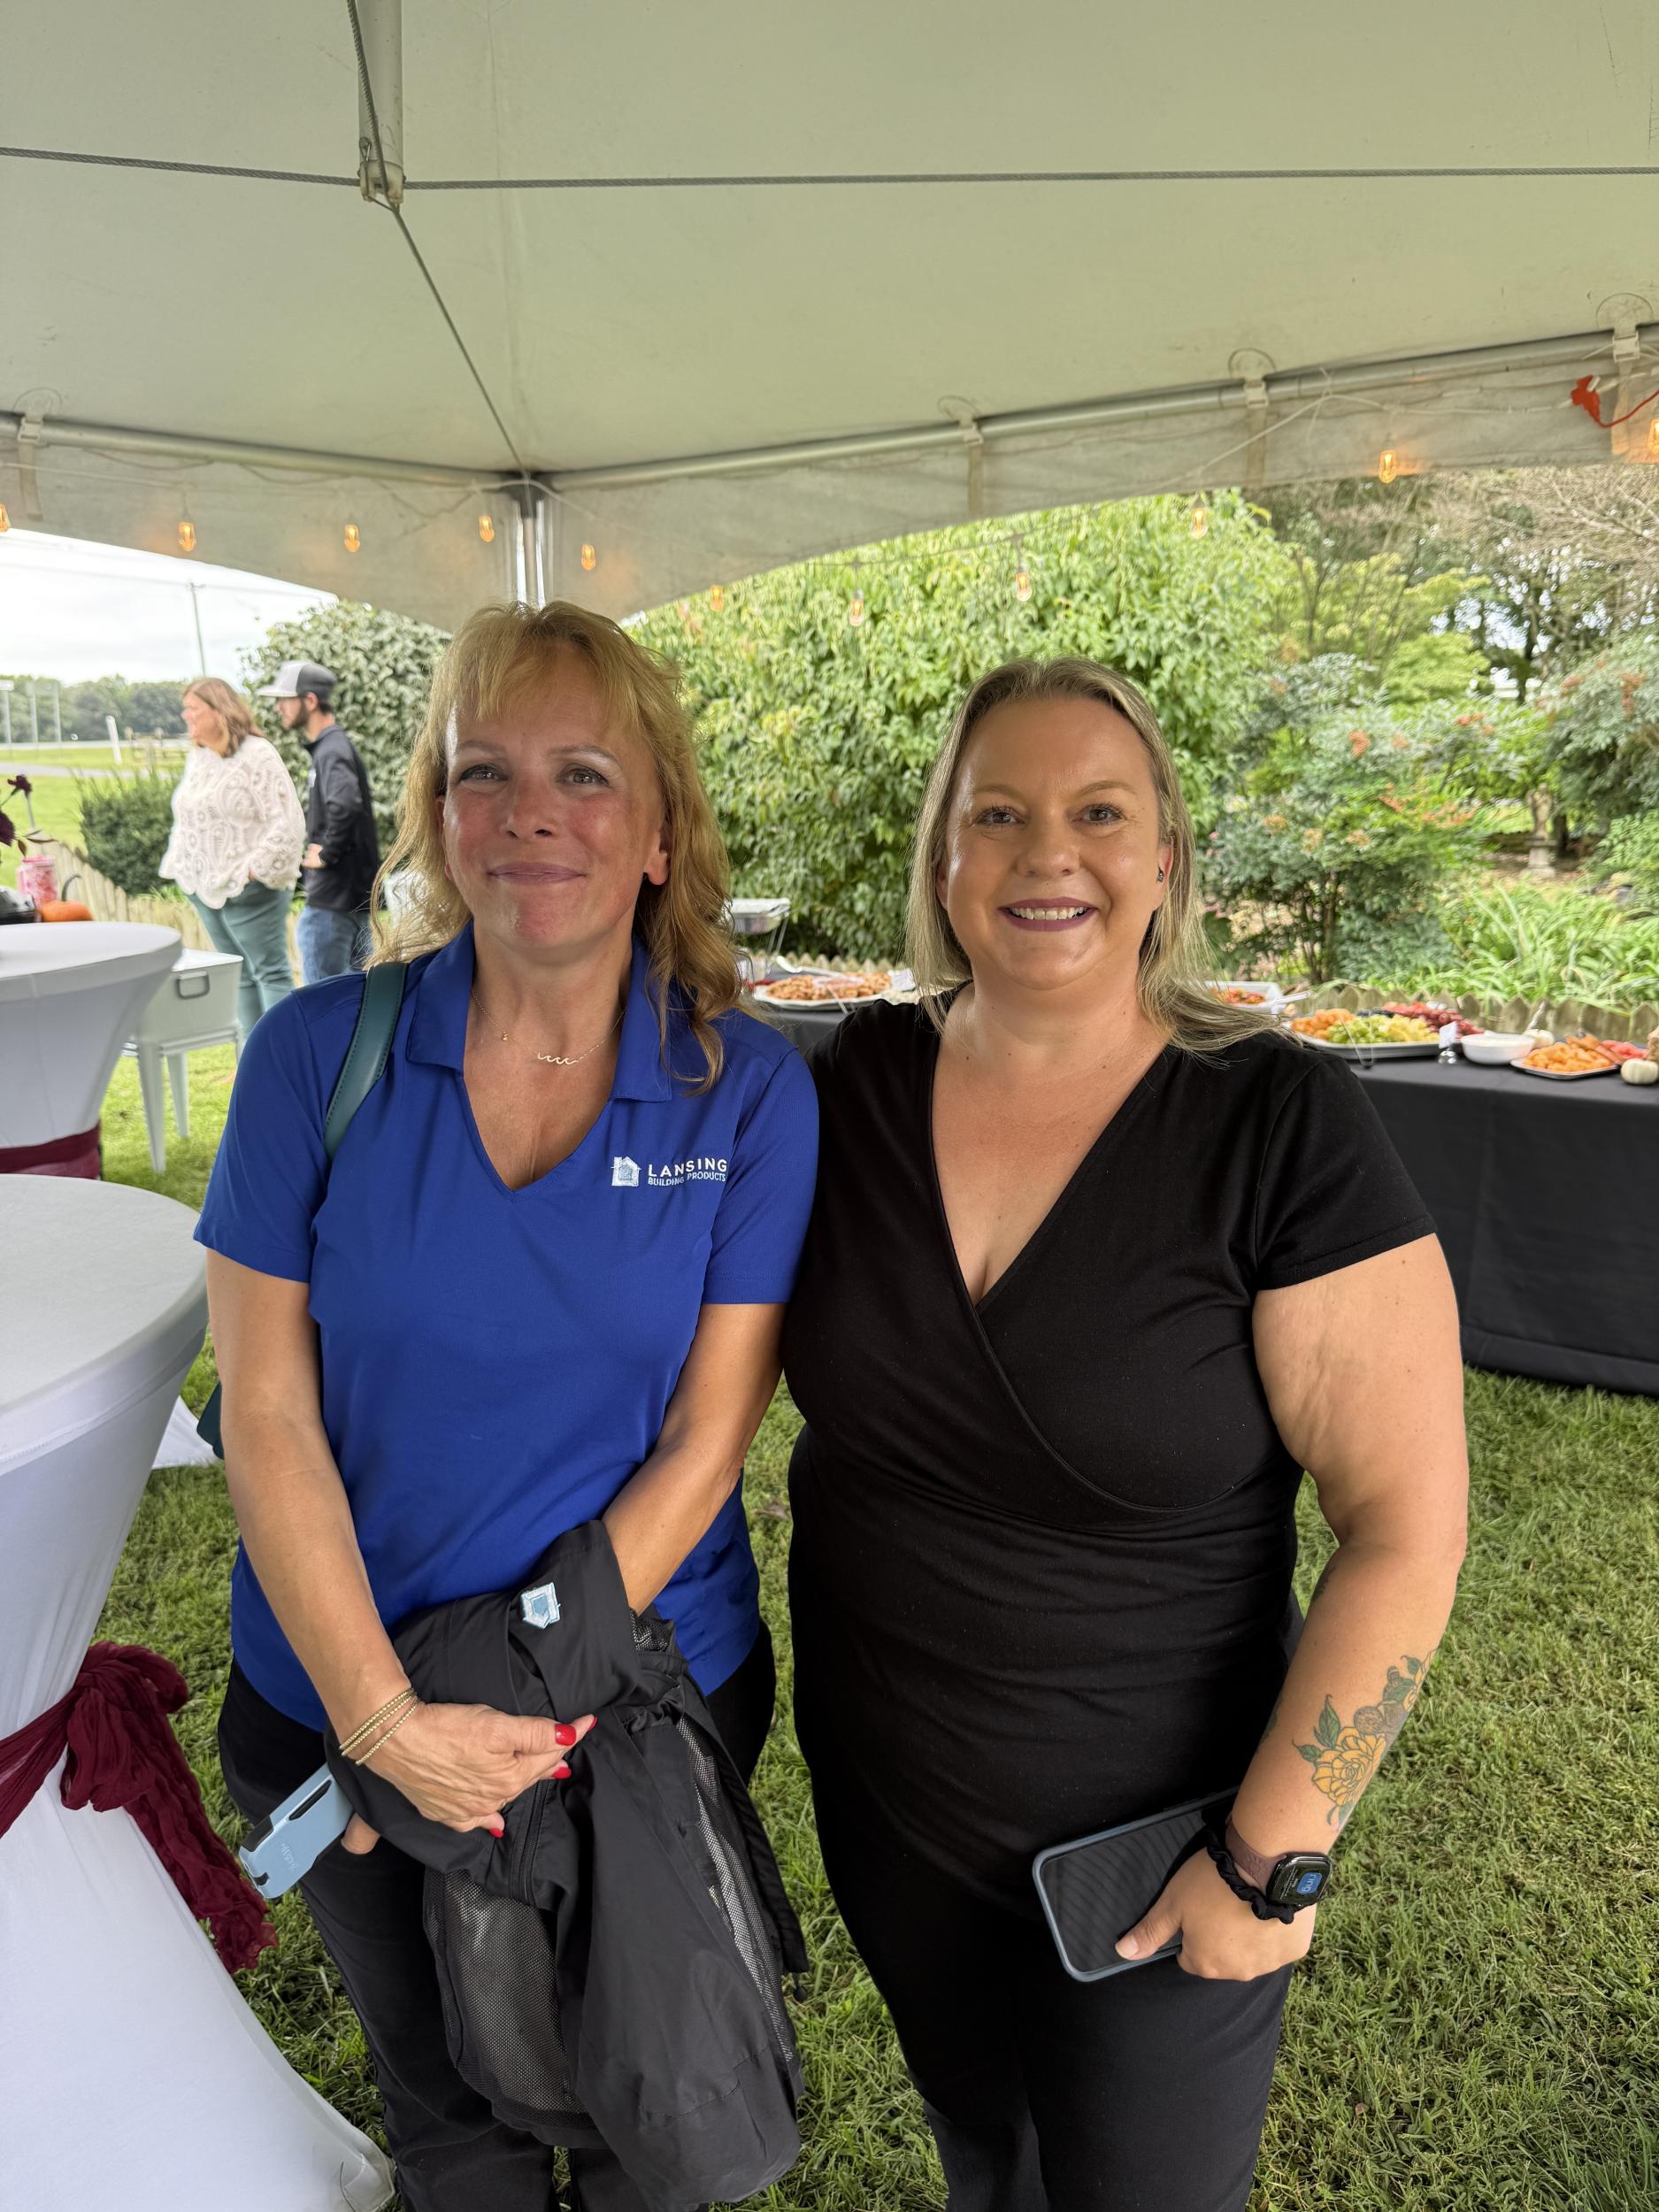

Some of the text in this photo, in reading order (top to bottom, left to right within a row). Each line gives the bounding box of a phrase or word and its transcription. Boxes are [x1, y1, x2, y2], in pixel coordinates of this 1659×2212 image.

[648, 1157, 727, 1178] LANSING
[648, 1171, 726, 1187] BUILDING PRODUCTS
[1302, 1874, 1317, 1892] ring
